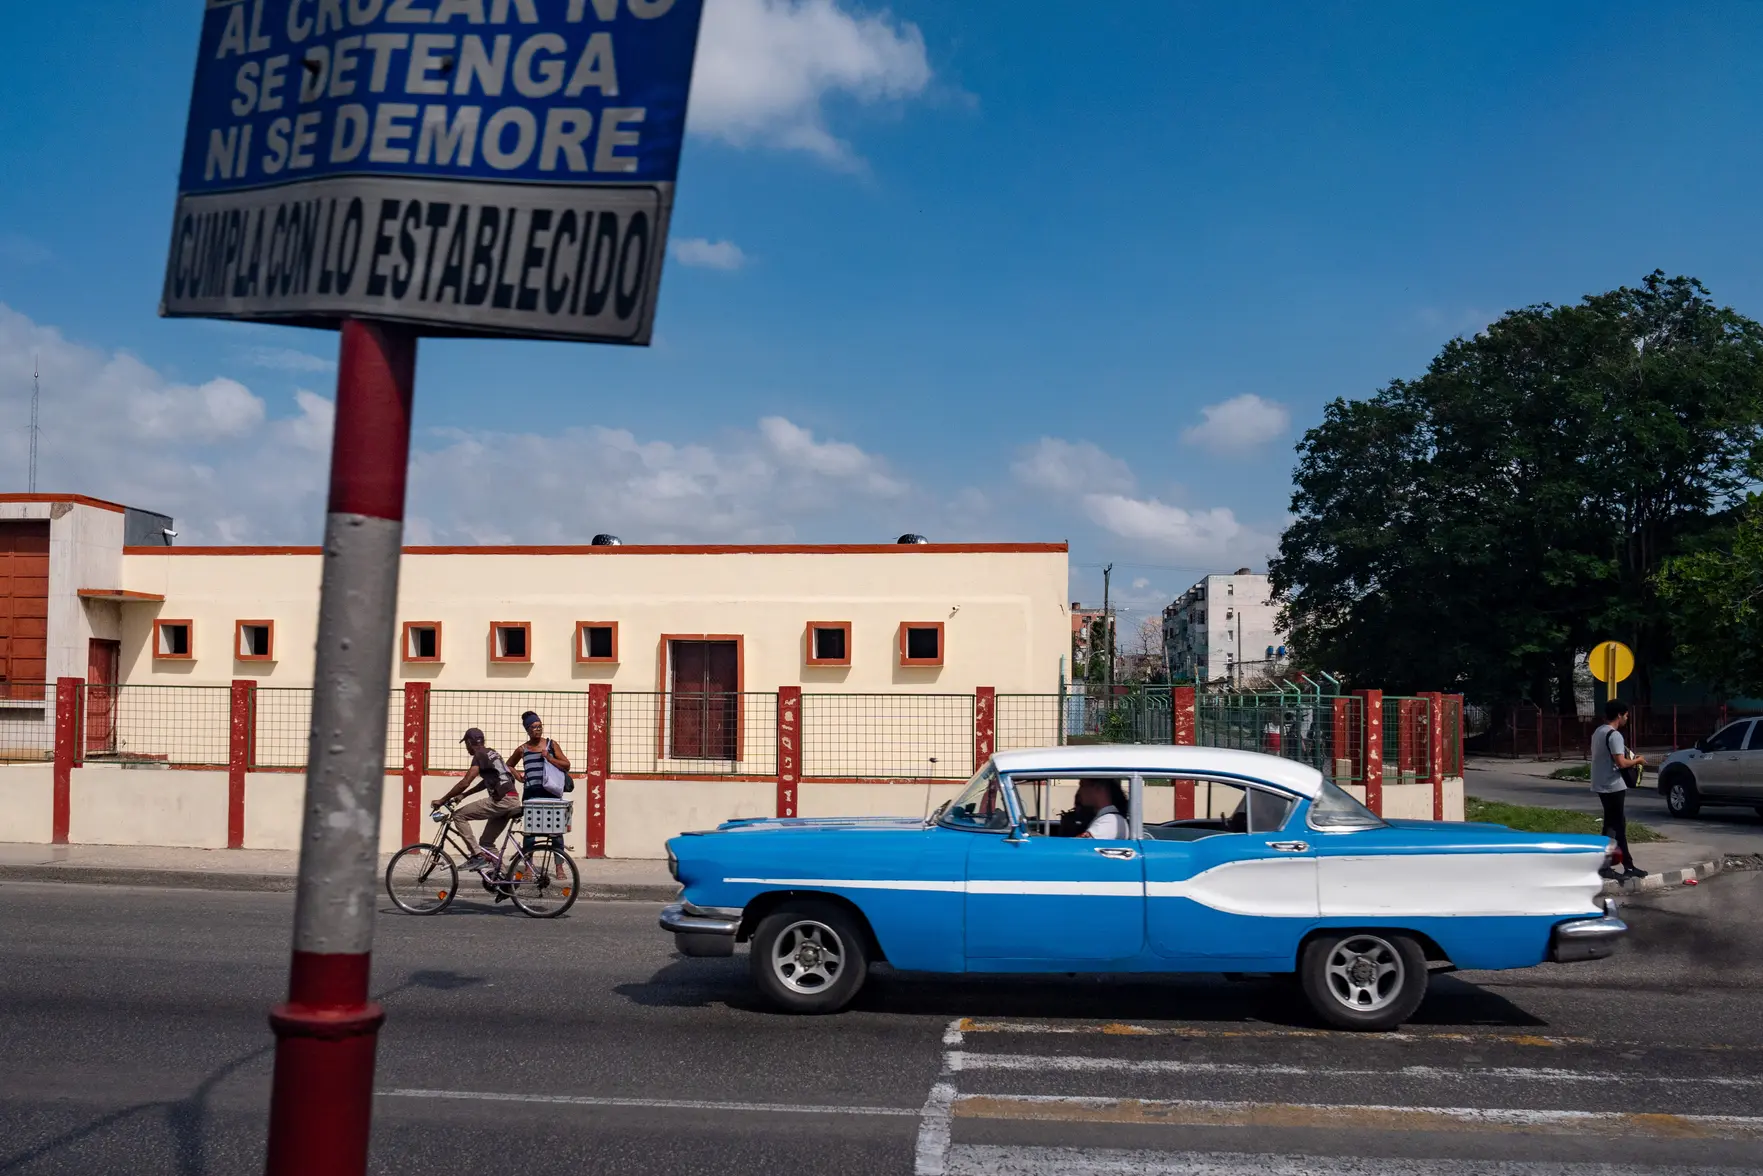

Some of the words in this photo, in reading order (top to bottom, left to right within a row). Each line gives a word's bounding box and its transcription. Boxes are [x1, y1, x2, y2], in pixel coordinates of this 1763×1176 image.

[215, 0, 271, 59] AL
[231, 54, 289, 117] SE
[298, 32, 619, 104] DETENGA
[204, 125, 251, 180] NI
[262, 111, 320, 174] SE
[329, 103, 646, 172] DEMORE
[174, 207, 264, 299] CUMPLA
[265, 198, 322, 298] CON
[317, 197, 363, 296] LO
[366, 198, 650, 320] ESTABLECIDO
